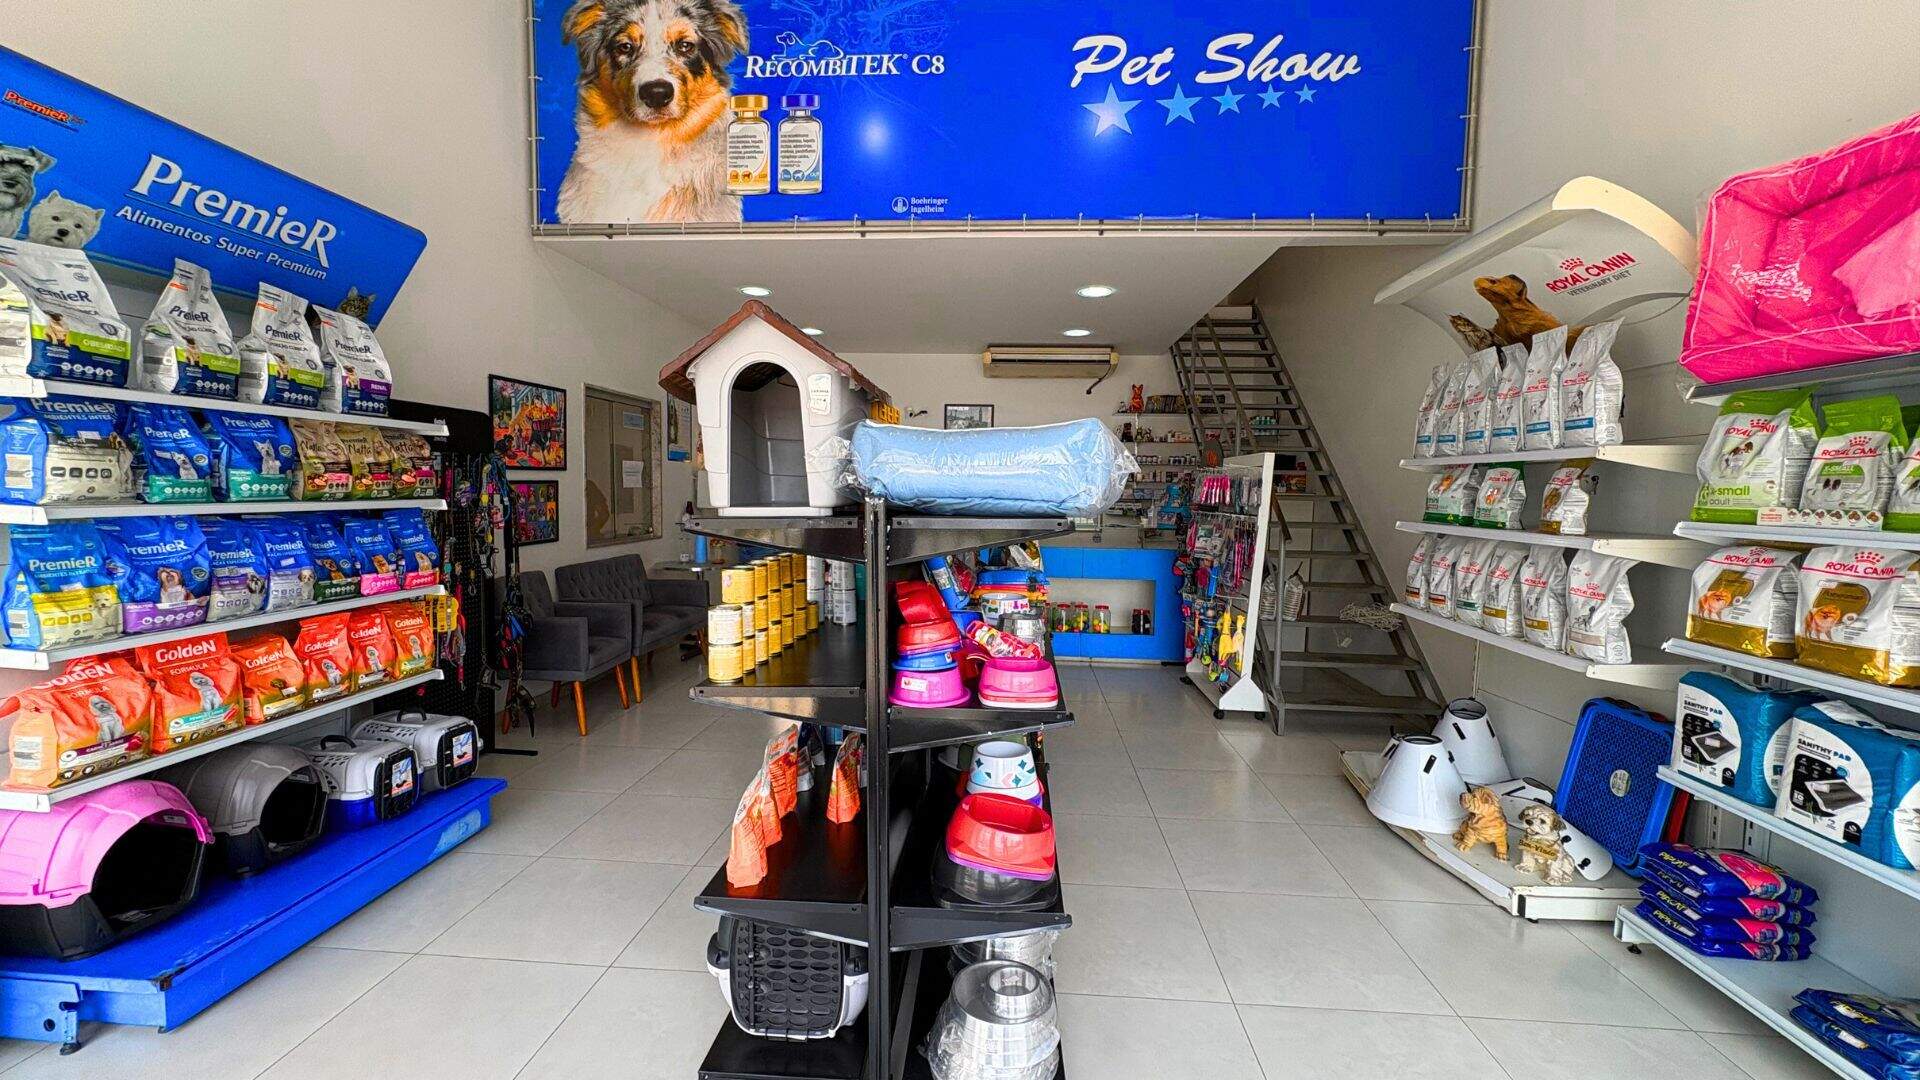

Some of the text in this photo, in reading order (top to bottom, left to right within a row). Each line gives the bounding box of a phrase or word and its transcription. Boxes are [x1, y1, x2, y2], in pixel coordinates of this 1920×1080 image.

[911, 54, 945, 75] C8
[1071, 33, 1361, 88] Pet Show
[131, 154, 336, 268] PremieR
[910, 197, 948, 207] Boehringer
[116, 205, 327, 281] Alimentos Super Premium
[1546, 251, 1636, 293] ROYAL CANIN
[1567, 270, 1633, 297] VETERINARY DIET
[28, 555, 98, 572] PremieR
[1724, 554, 1751, 563] ROYAL
[1824, 561, 1898, 576] ROYAL CANIN
[156, 639, 217, 663] GoldeN
[245, 650, 285, 669] GoldeN
[1684, 699, 1723, 715] SANITHY PAD
[1798, 738, 1852, 761] SANITHY PAD
